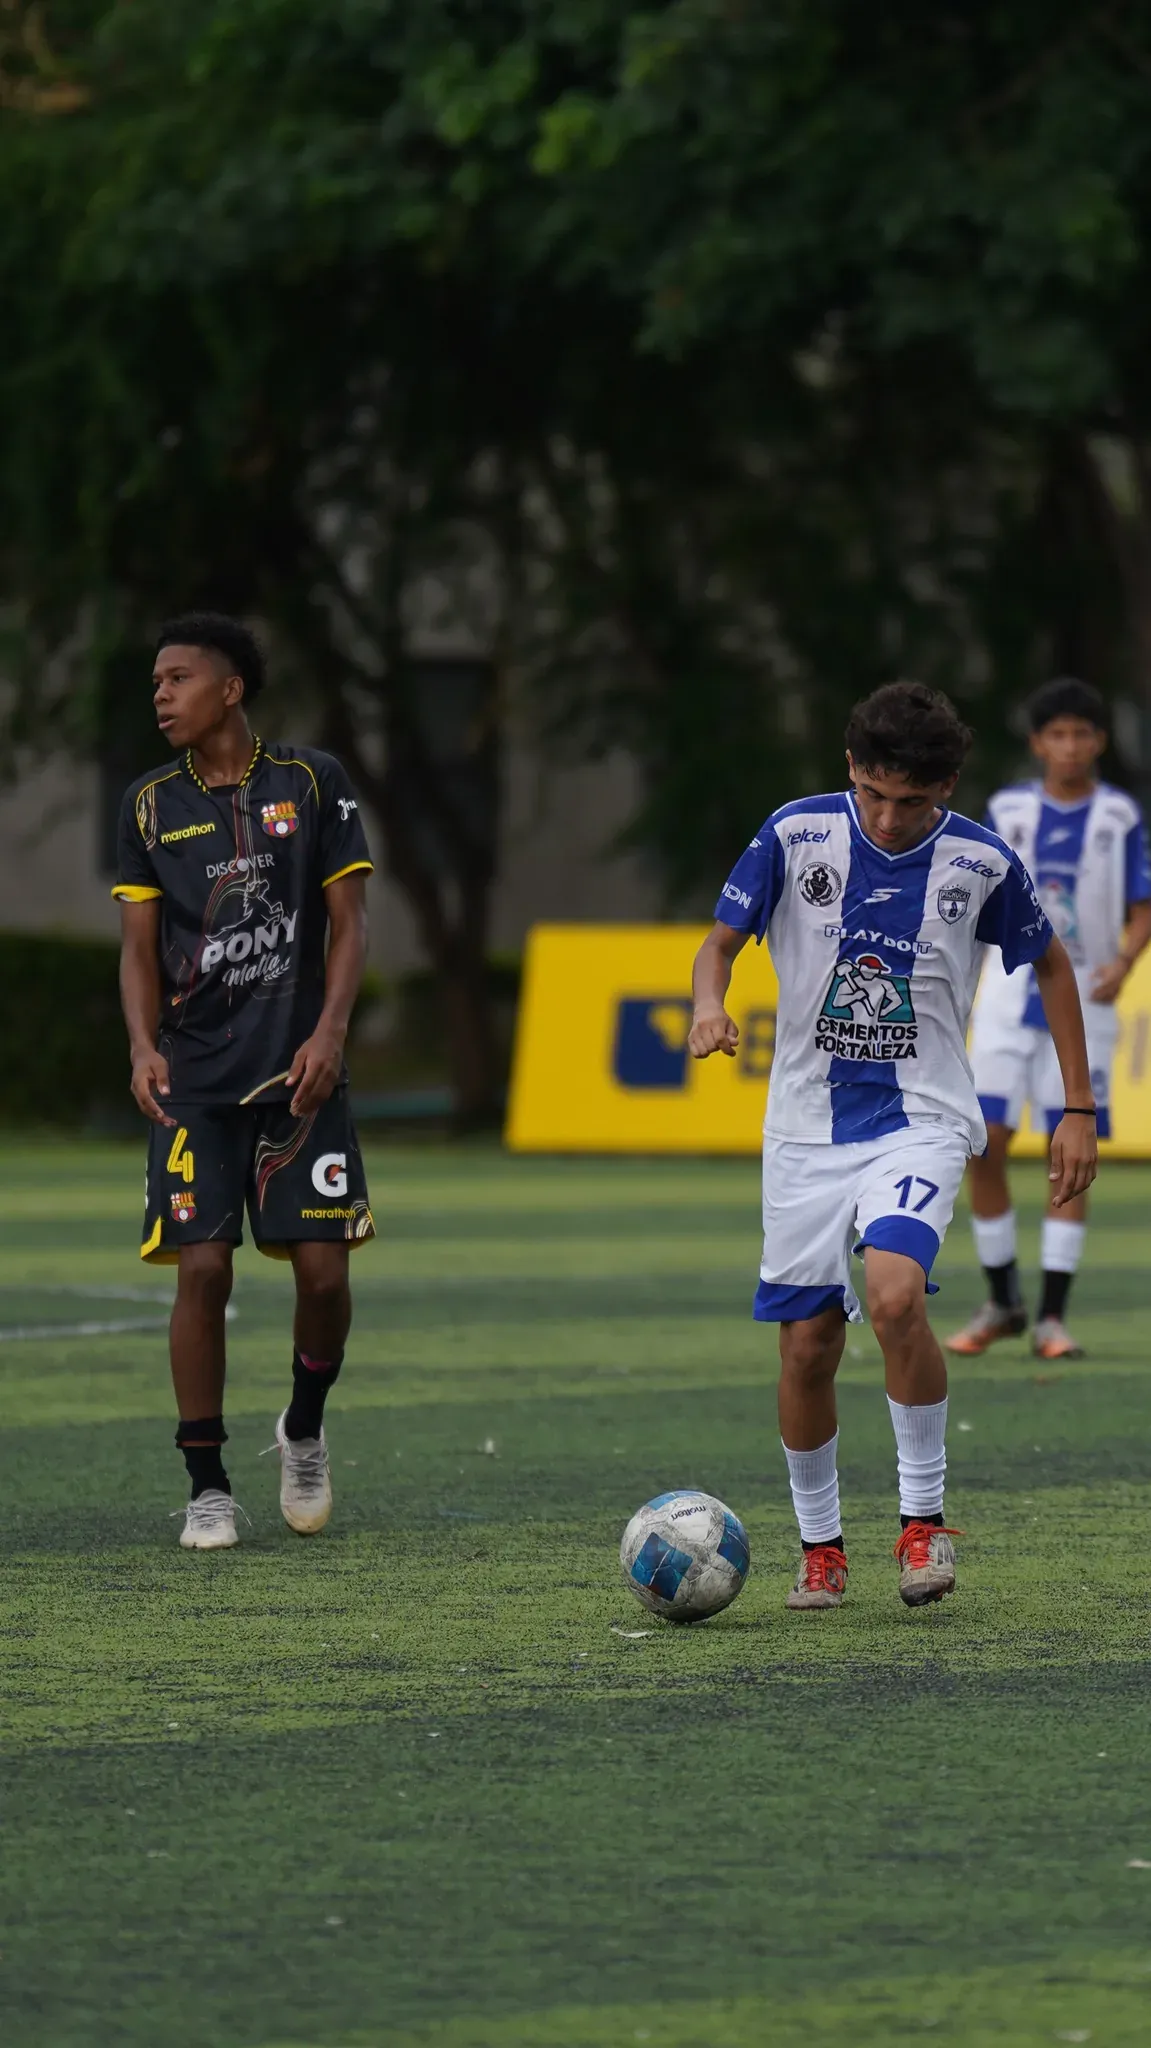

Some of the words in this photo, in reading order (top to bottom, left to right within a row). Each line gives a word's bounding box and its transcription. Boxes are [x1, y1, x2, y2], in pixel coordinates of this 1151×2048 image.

[160, 822, 216, 844] marathon
[787, 828, 831, 847] telcel
[206, 854, 276, 879] DISCOVER
[949, 855, 1002, 878] telcel
[201, 909, 298, 974] PONY
[222, 951, 281, 987] Malta
[816, 1018, 919, 1042] CEMENTOS
[814, 1034, 918, 1061] FORTALEZA
[166, 1127, 195, 1183] 4
[311, 1153, 348, 1198] G
[893, 1174, 940, 1213] 17
[301, 1206, 356, 1219] marathon
[671, 1505, 707, 1521] molten
